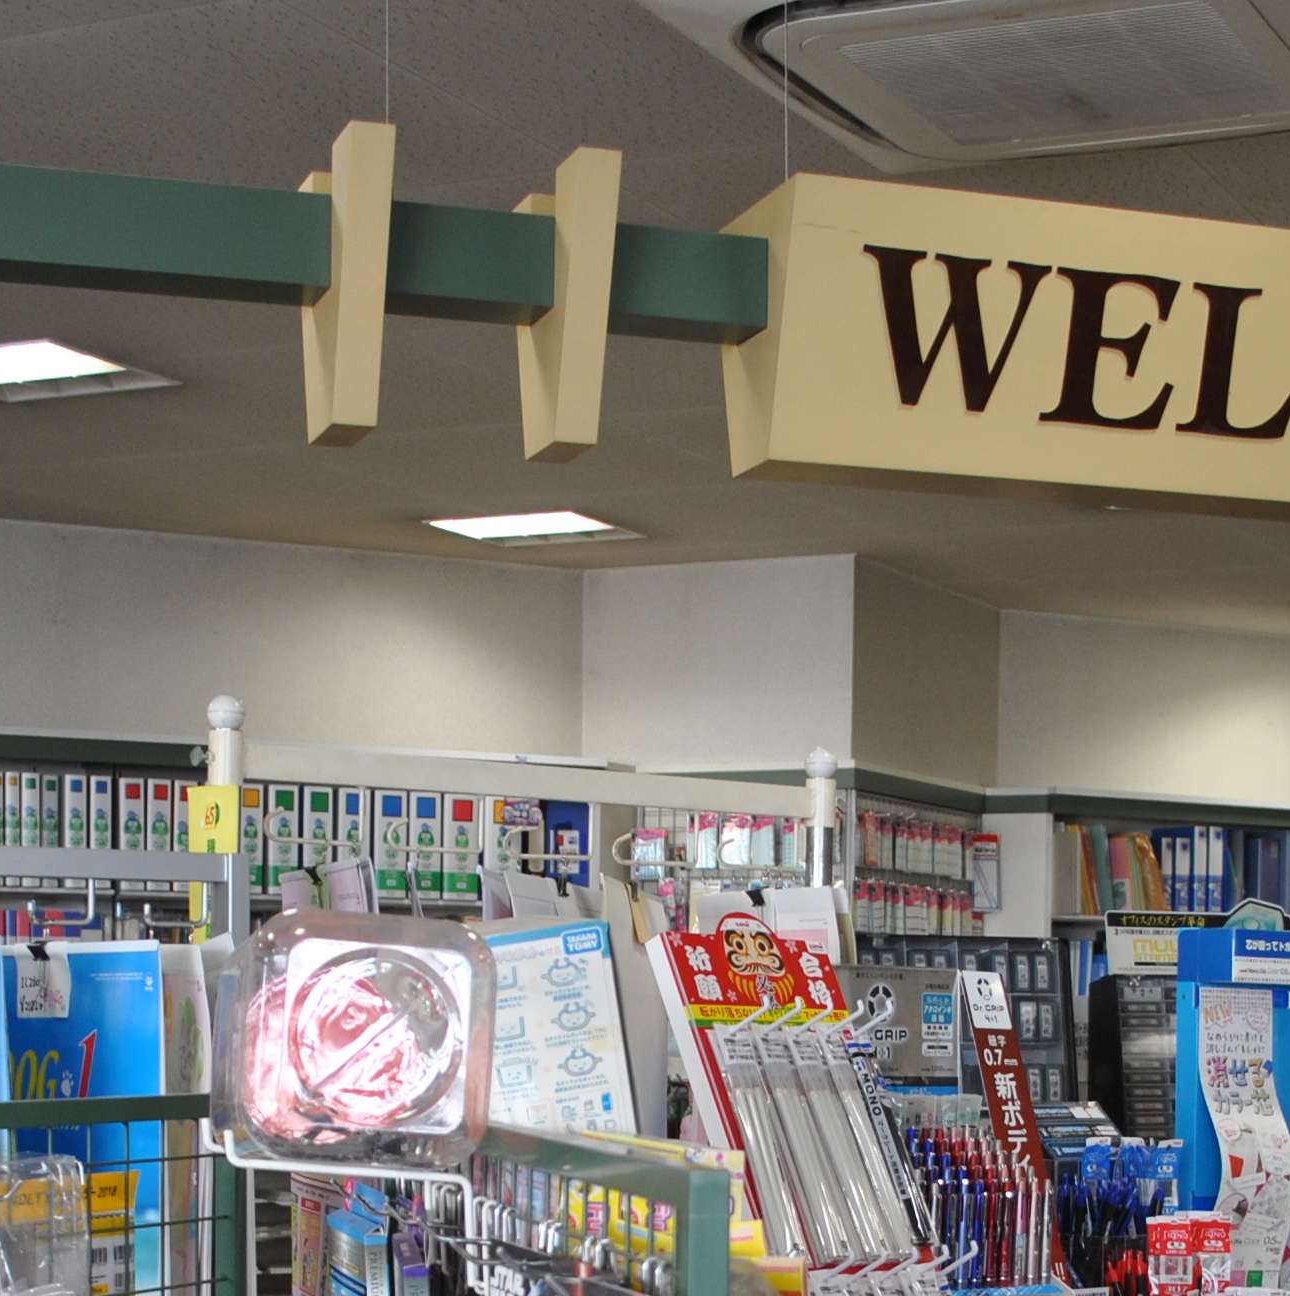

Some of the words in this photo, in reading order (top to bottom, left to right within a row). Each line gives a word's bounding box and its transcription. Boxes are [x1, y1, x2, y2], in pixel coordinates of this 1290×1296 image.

[564, 931, 599, 943] TAKARA
[566, 940, 601, 955] TOMY
[1203, 1001, 1232, 1025] NEW
[1205, 1056, 1273, 1088] 消せる
[861, 1073, 882, 1117] MONO
[97, 1183, 118, 1199] 2018
[490, 1265, 525, 1296] STAR
